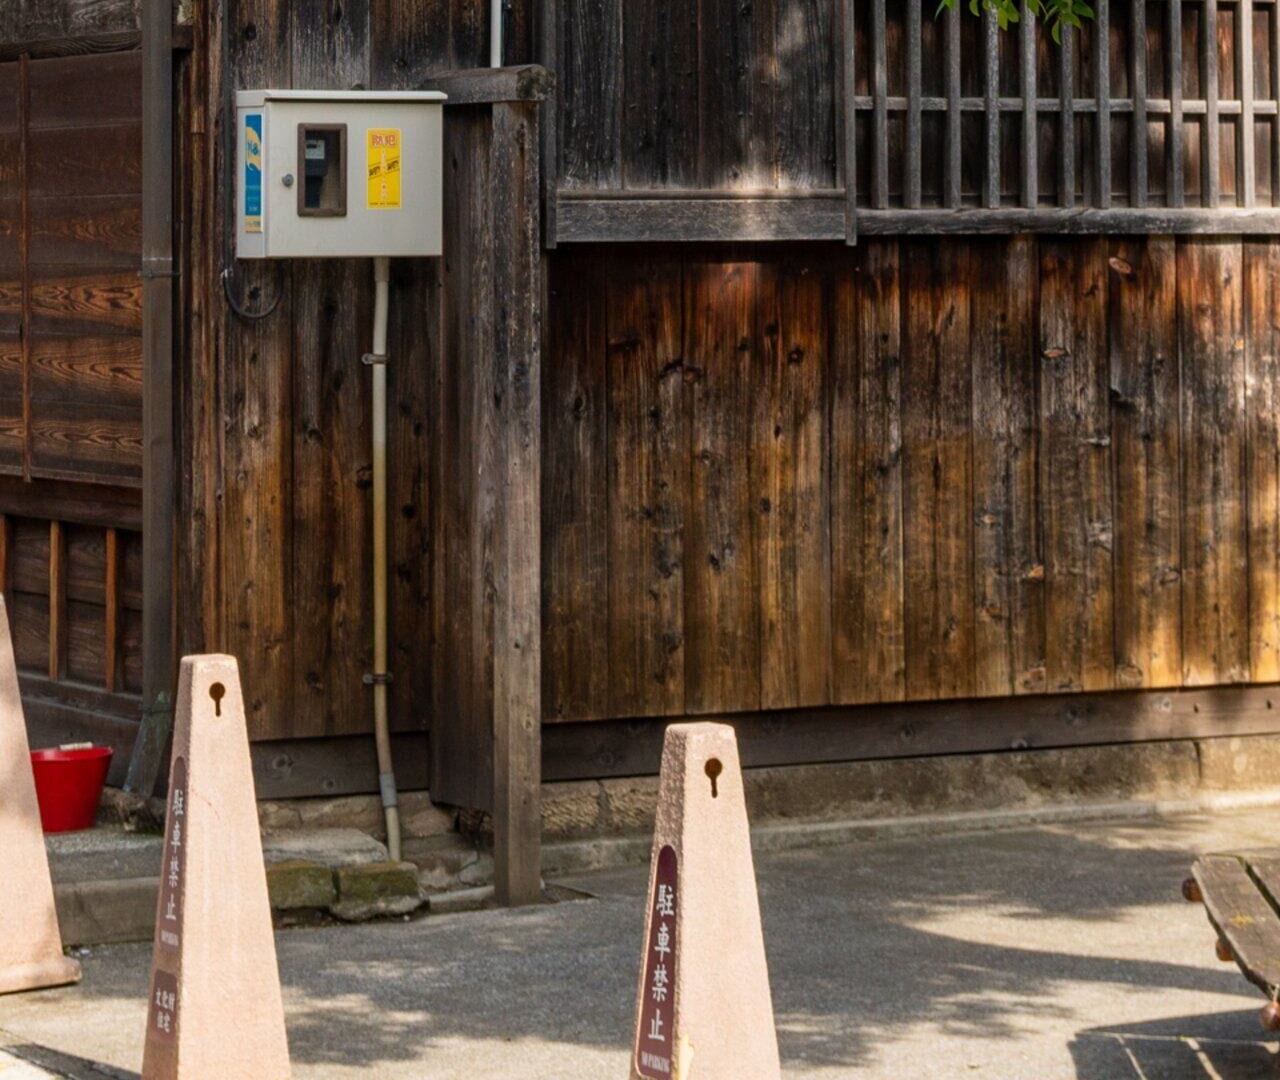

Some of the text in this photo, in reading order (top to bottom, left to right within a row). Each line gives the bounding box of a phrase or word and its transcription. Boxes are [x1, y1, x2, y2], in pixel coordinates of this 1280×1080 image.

[165, 788, 184, 920] 駐車禁止
[648, 884, 675, 1041] 駐車禁止
